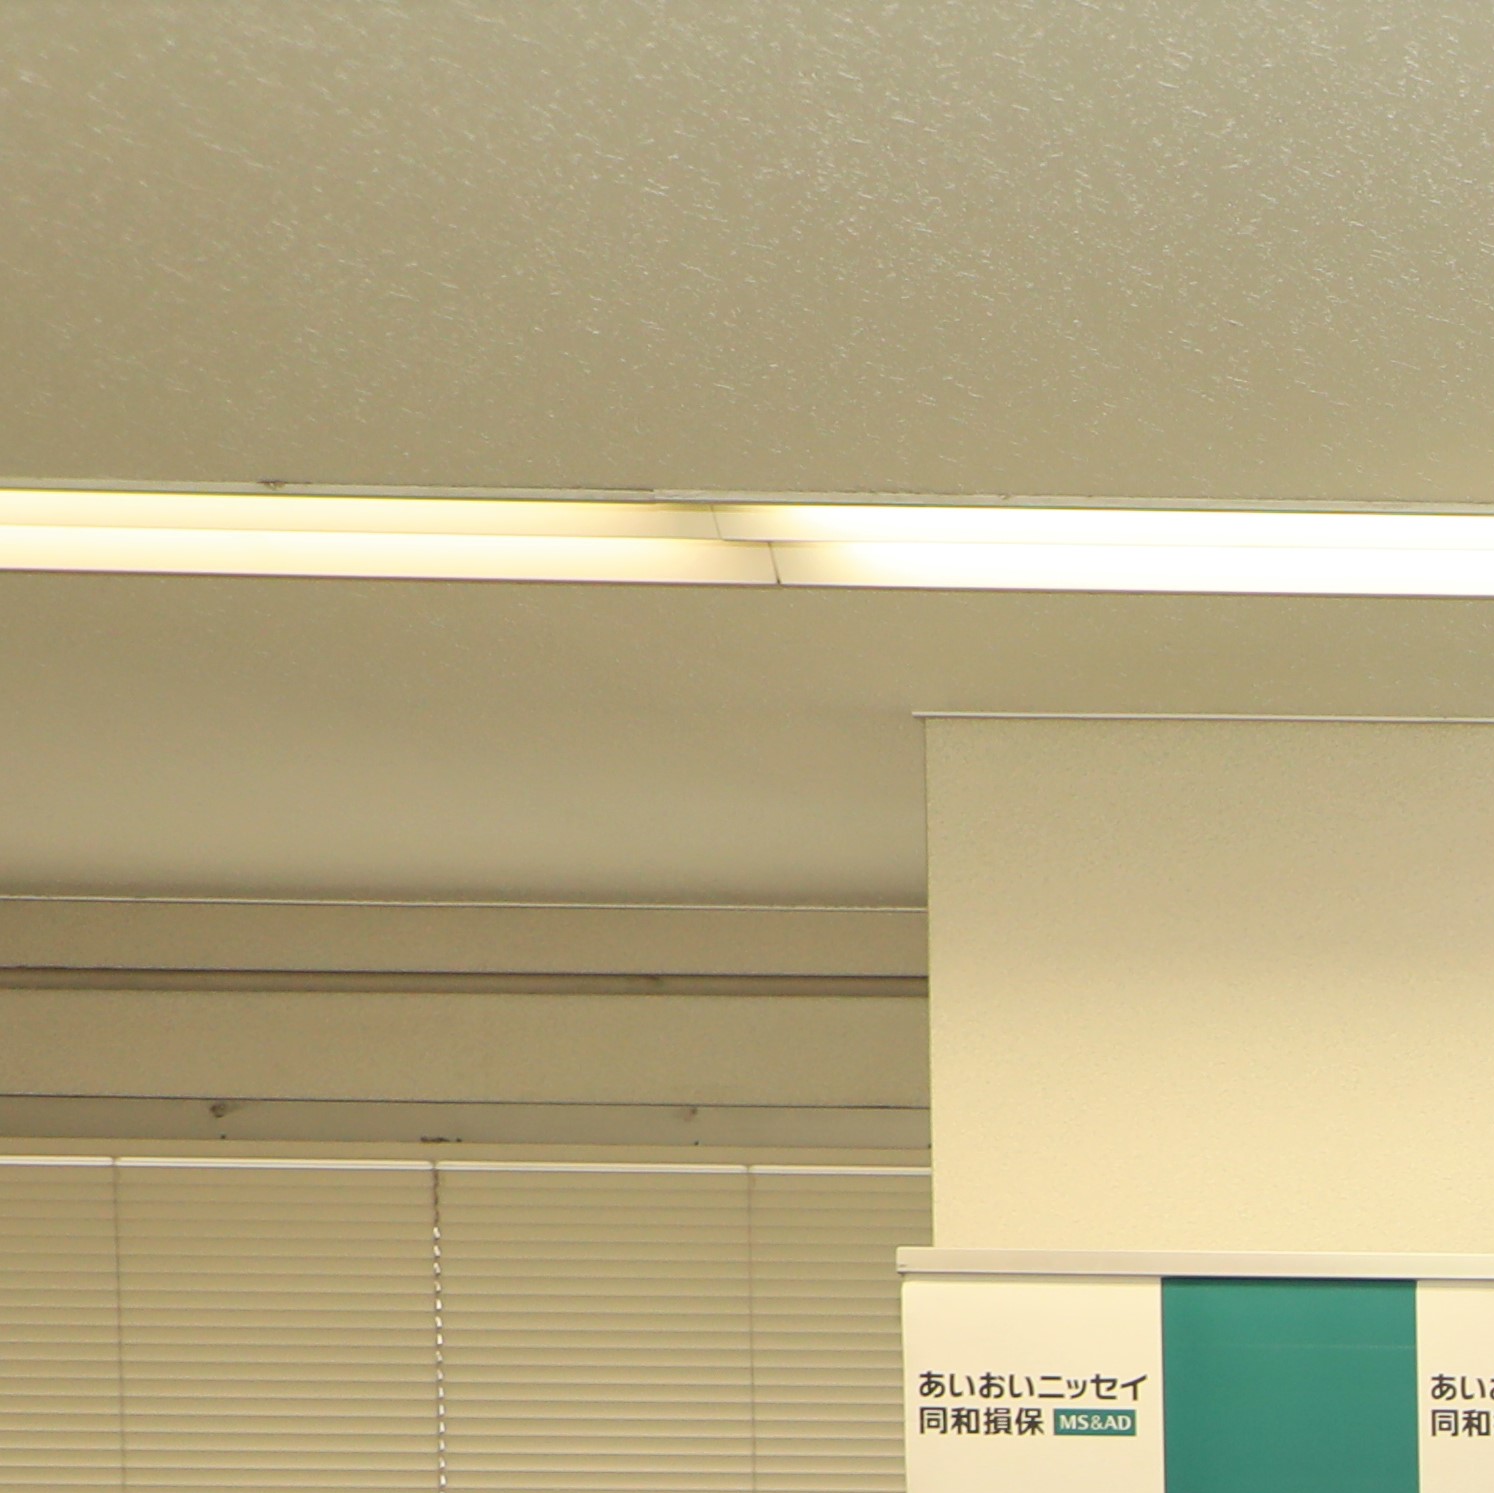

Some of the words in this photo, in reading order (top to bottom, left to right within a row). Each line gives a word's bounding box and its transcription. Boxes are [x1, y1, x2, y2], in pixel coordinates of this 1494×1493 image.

[919, 1370, 1148, 1401] あいおいニッセイ
[919, 1406, 1045, 1436] 同和損保
[1058, 1413, 1133, 1433] MS&AD
